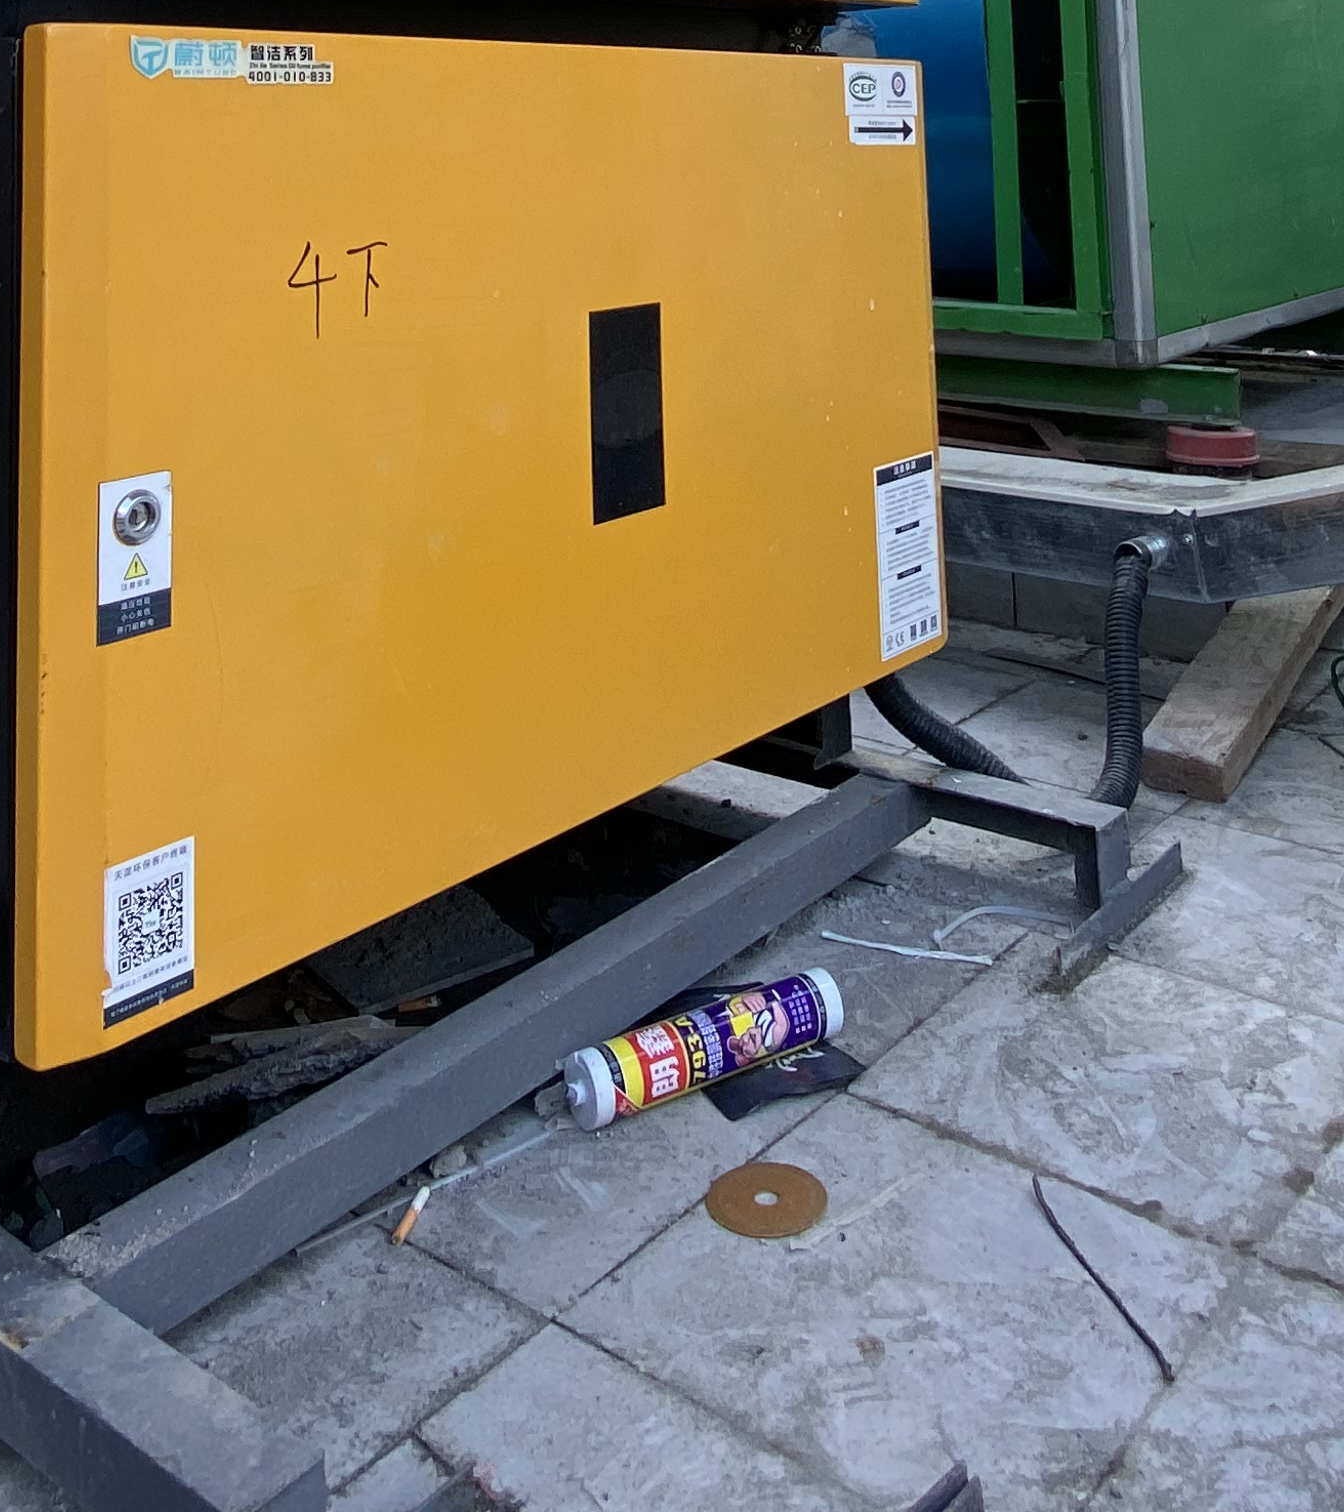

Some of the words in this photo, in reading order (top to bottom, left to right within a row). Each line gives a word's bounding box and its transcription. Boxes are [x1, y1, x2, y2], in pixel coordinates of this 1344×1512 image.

[250, 45, 313, 61] 智洁系列
[248, 71, 331, 82] 4001-010-833
[852, 83, 876, 94] CEP
